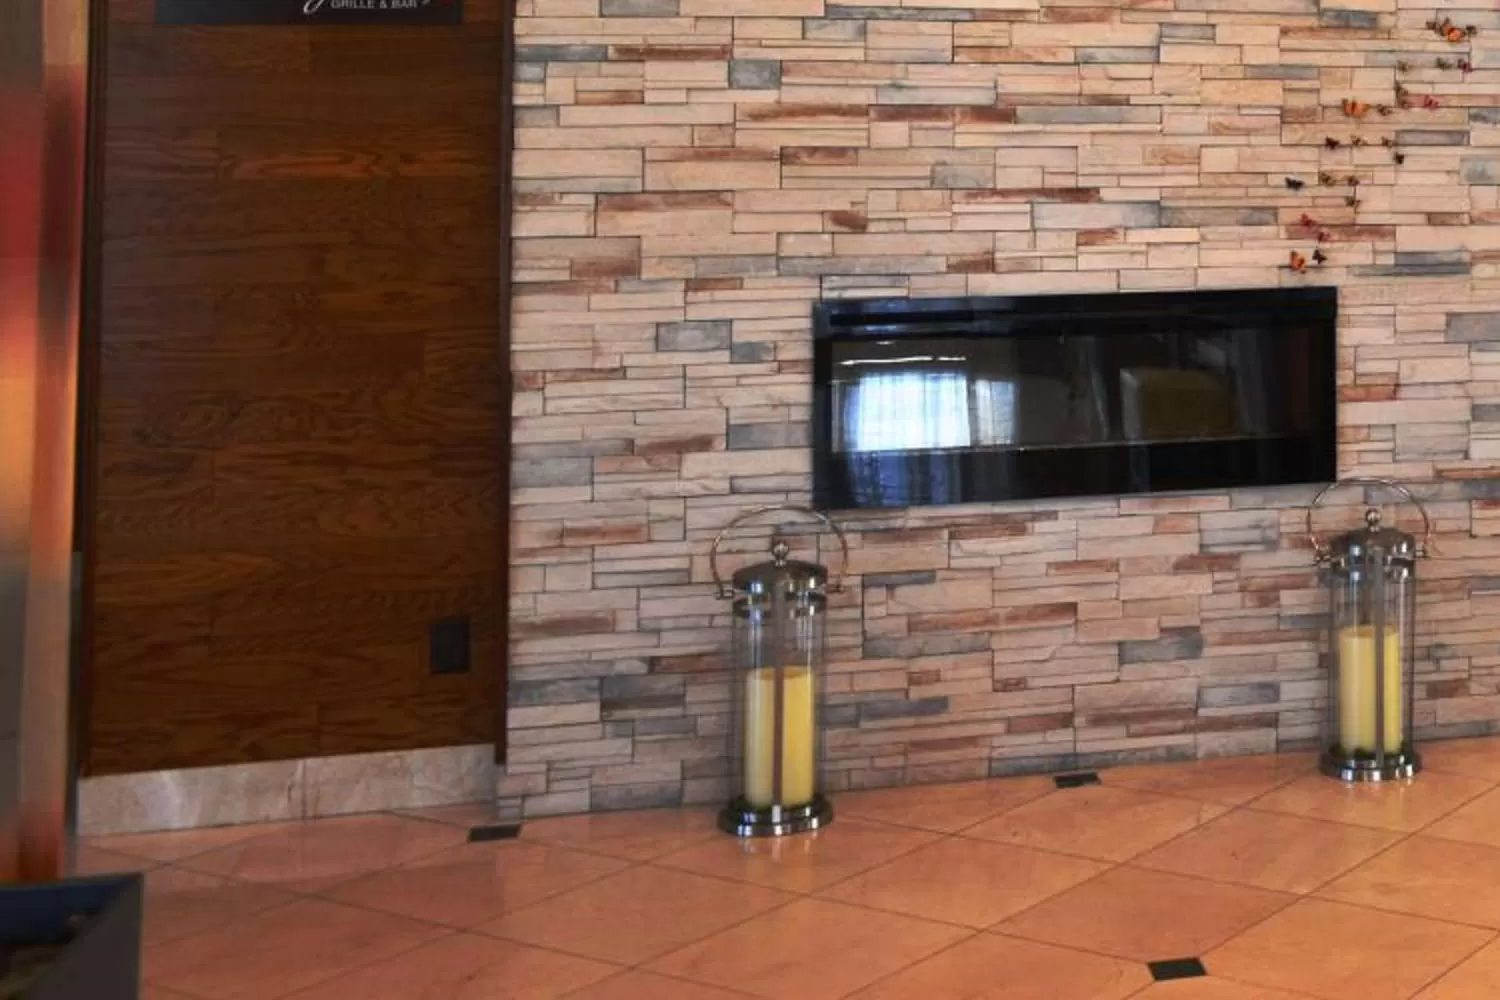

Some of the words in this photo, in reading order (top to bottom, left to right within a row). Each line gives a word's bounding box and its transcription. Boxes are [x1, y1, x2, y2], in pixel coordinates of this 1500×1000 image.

[331, 0, 375, 9] GRILLE
[380, 0, 388, 9] &
[391, 0, 417, 9] BAR
